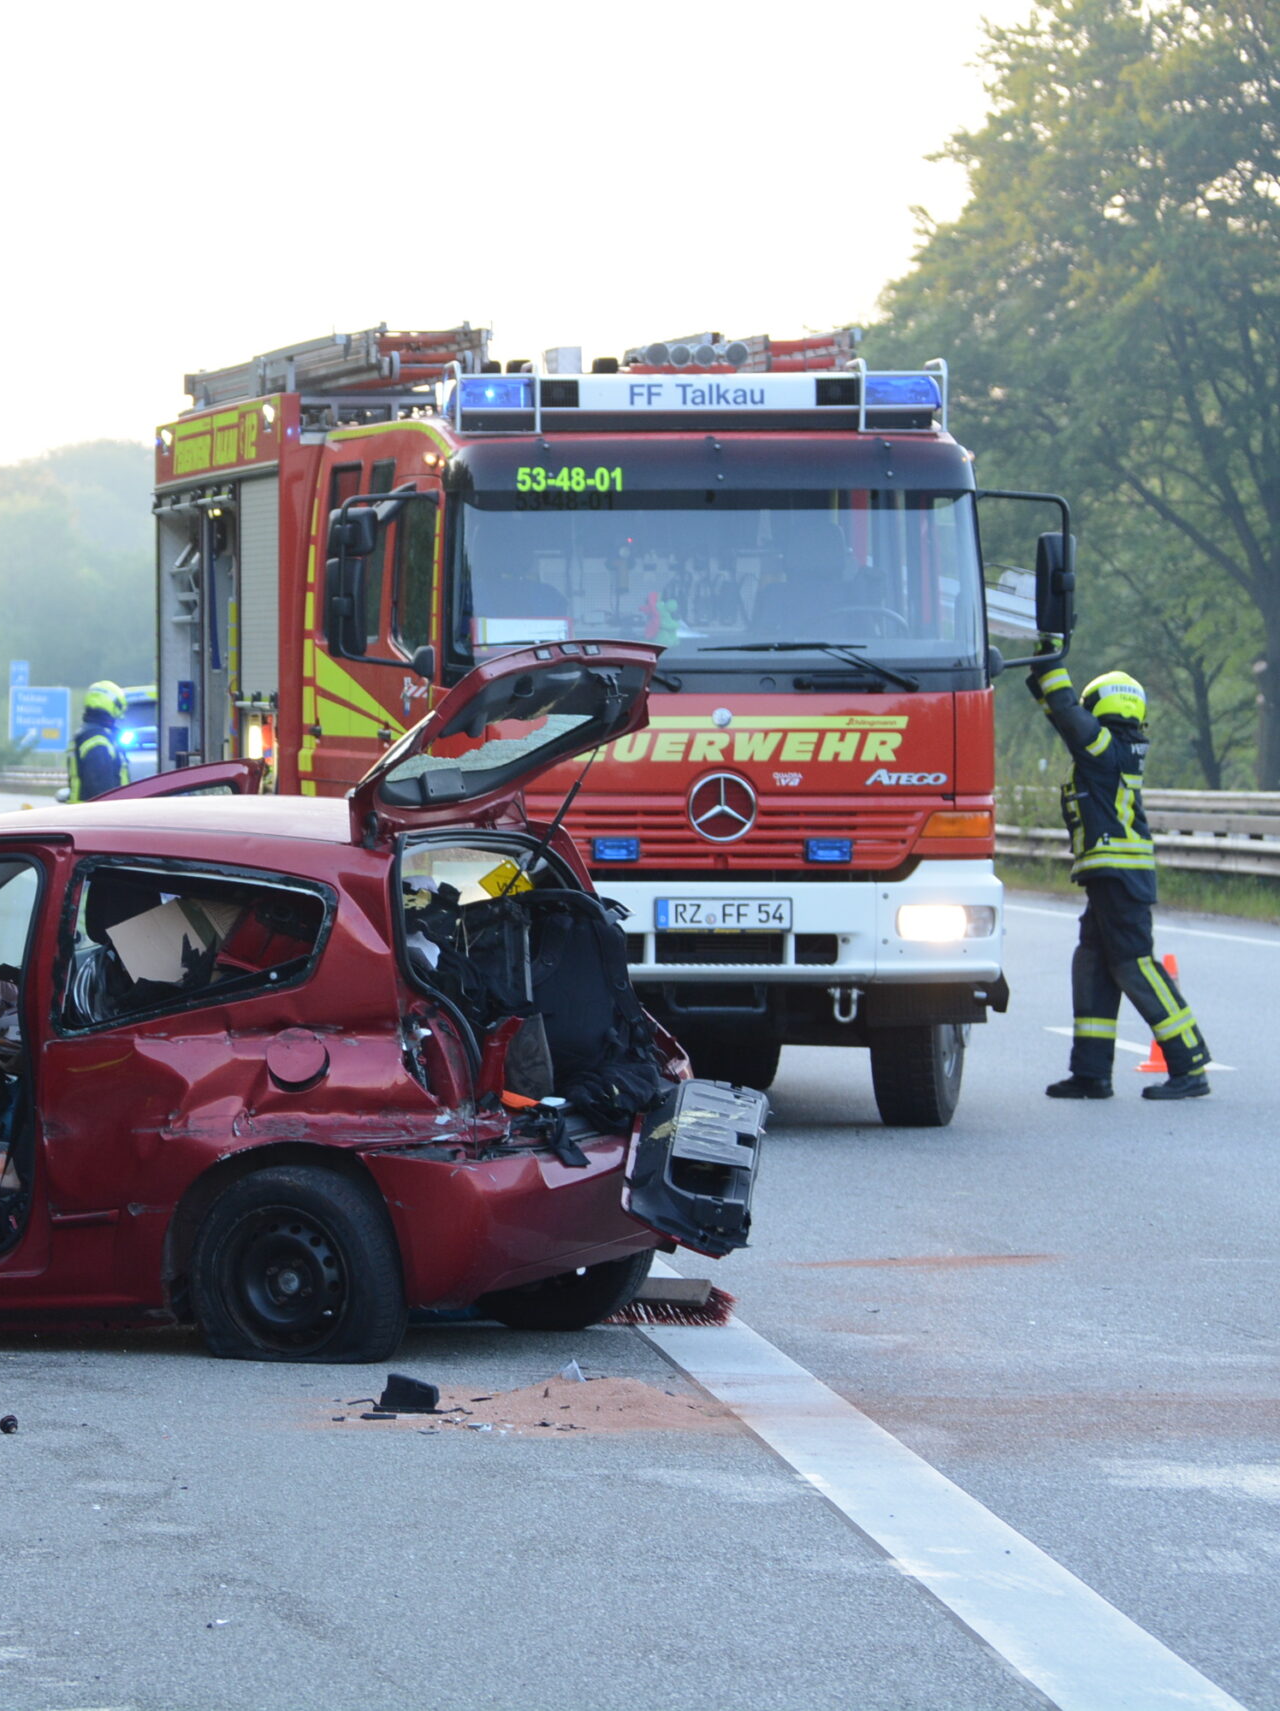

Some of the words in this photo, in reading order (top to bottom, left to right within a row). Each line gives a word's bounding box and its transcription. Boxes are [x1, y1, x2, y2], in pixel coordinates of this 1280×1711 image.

[629, 384, 663, 405] FF
[675, 384, 765, 405] Talkau
[516, 467, 623, 491] 53-48-01
[572, 731, 903, 762] EUERWEHR
[865, 768, 947, 786] ATEGO
[674, 903, 703, 924] RZ
[722, 903, 750, 924] FF
[758, 903, 785, 924] 54
